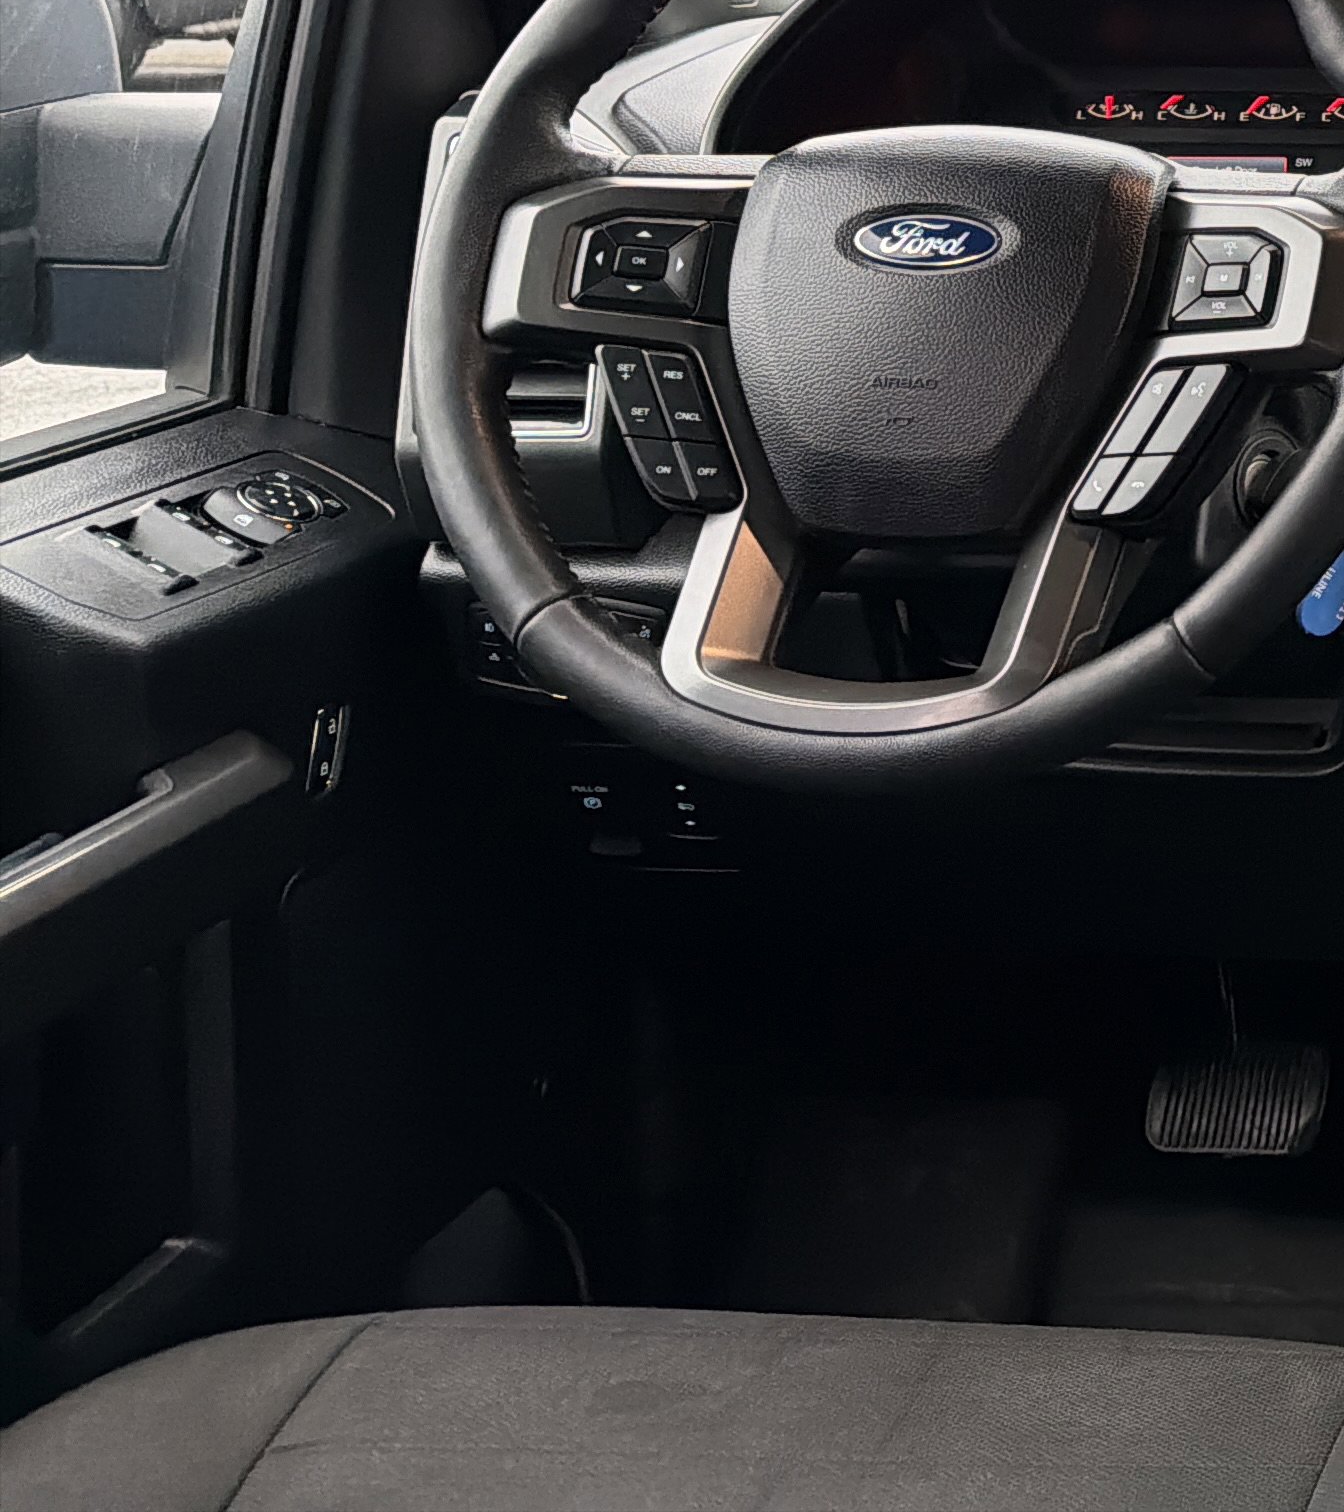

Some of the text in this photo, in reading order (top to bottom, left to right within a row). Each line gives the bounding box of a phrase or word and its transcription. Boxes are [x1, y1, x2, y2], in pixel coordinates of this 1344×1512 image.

[1076, 111, 1144, 121] L H
[1157, 111, 1226, 121] C H
[1239, 112, 1307, 122] E F
[1295, 157, 1314, 168] SW
[879, 220, 971, 256] Ford
[631, 256, 647, 266] OK
[616, 363, 636, 373] SET
[663, 370, 684, 380] RES
[630, 406, 650, 416] SET
[674, 411, 702, 422] CNCL
[655, 465, 672, 476] ON
[697, 466, 718, 477] OFF
[1311, 566, 1337, 600] ULINE
